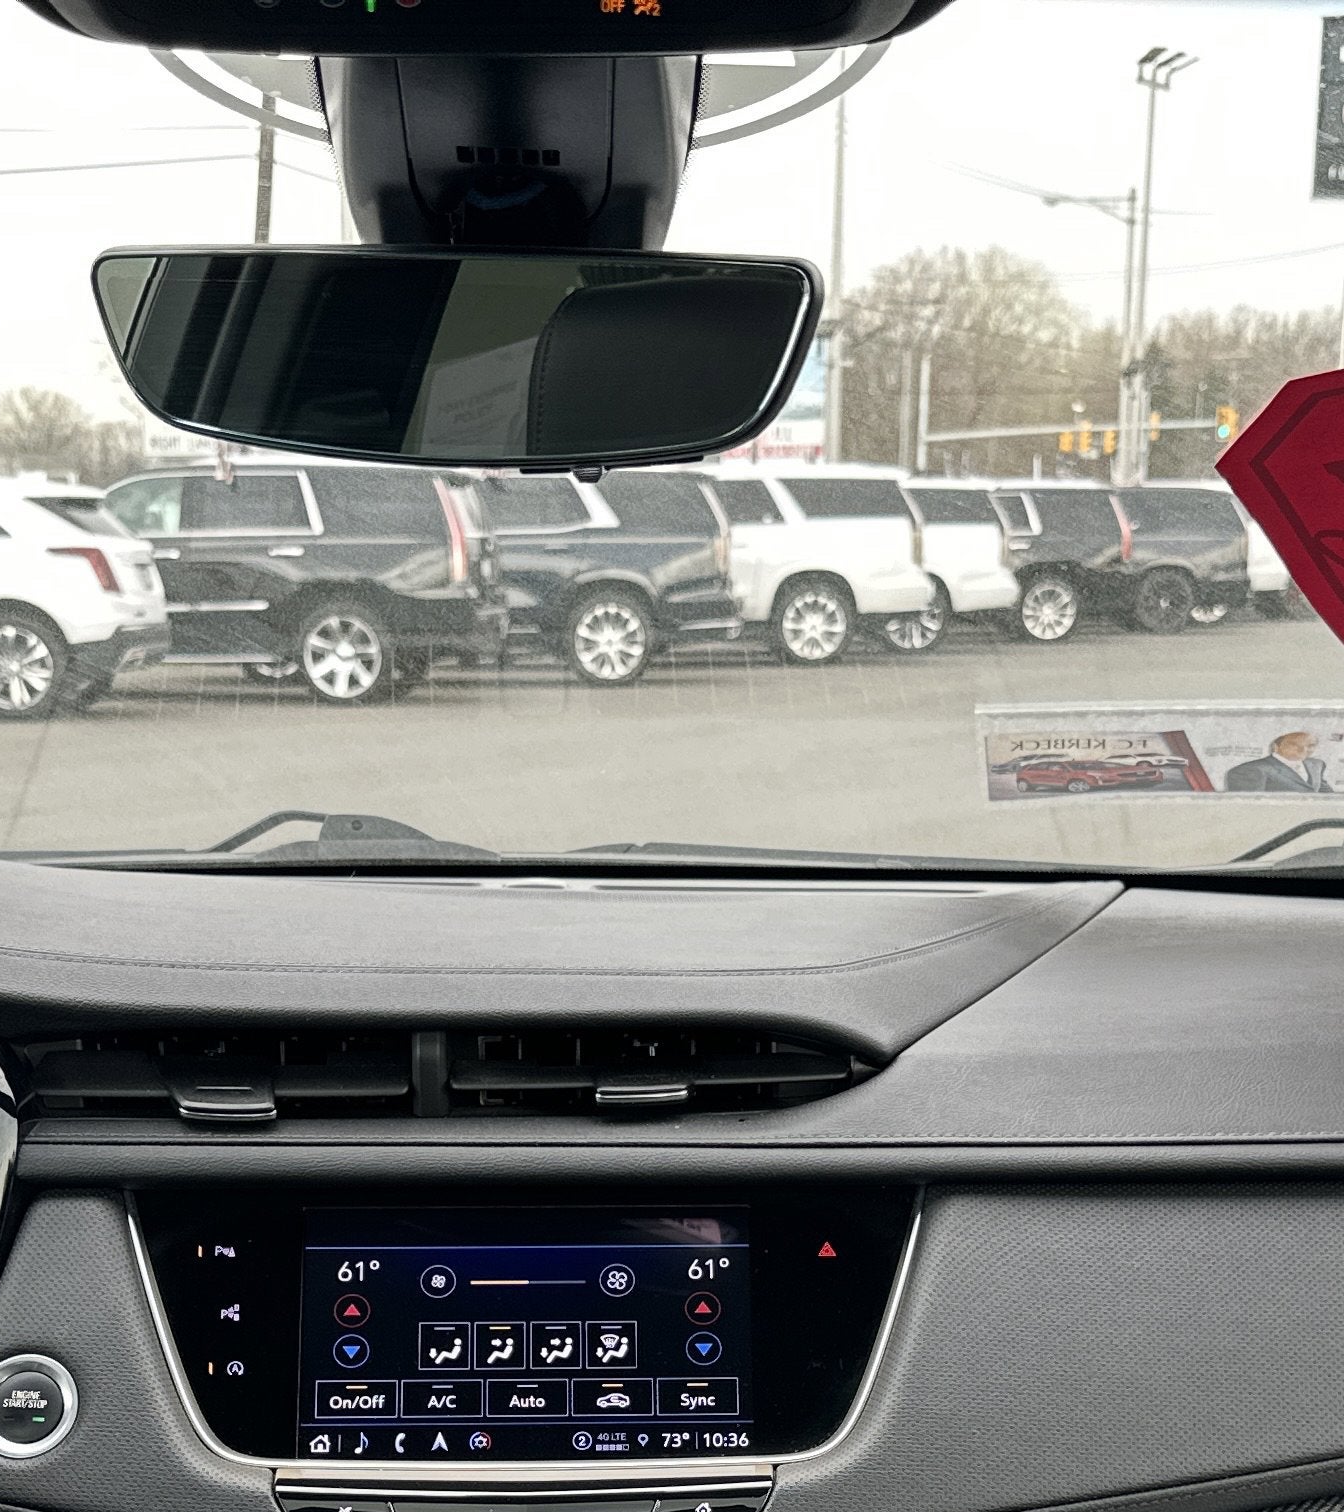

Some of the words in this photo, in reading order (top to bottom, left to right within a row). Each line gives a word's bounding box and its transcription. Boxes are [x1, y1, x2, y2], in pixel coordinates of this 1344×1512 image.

[337, 1260, 379, 1282] 61°
[688, 1257, 729, 1280] 61°
[329, 1395, 385, 1410] On/Off
[427, 1395, 456, 1409] A/C
[509, 1394, 545, 1408] Auto
[680, 1393, 716, 1409] Sync
[610, 1432, 626, 1440] LTE
[661, 1432, 690, 1448] 73°
[703, 1431, 749, 1448] 10:36
